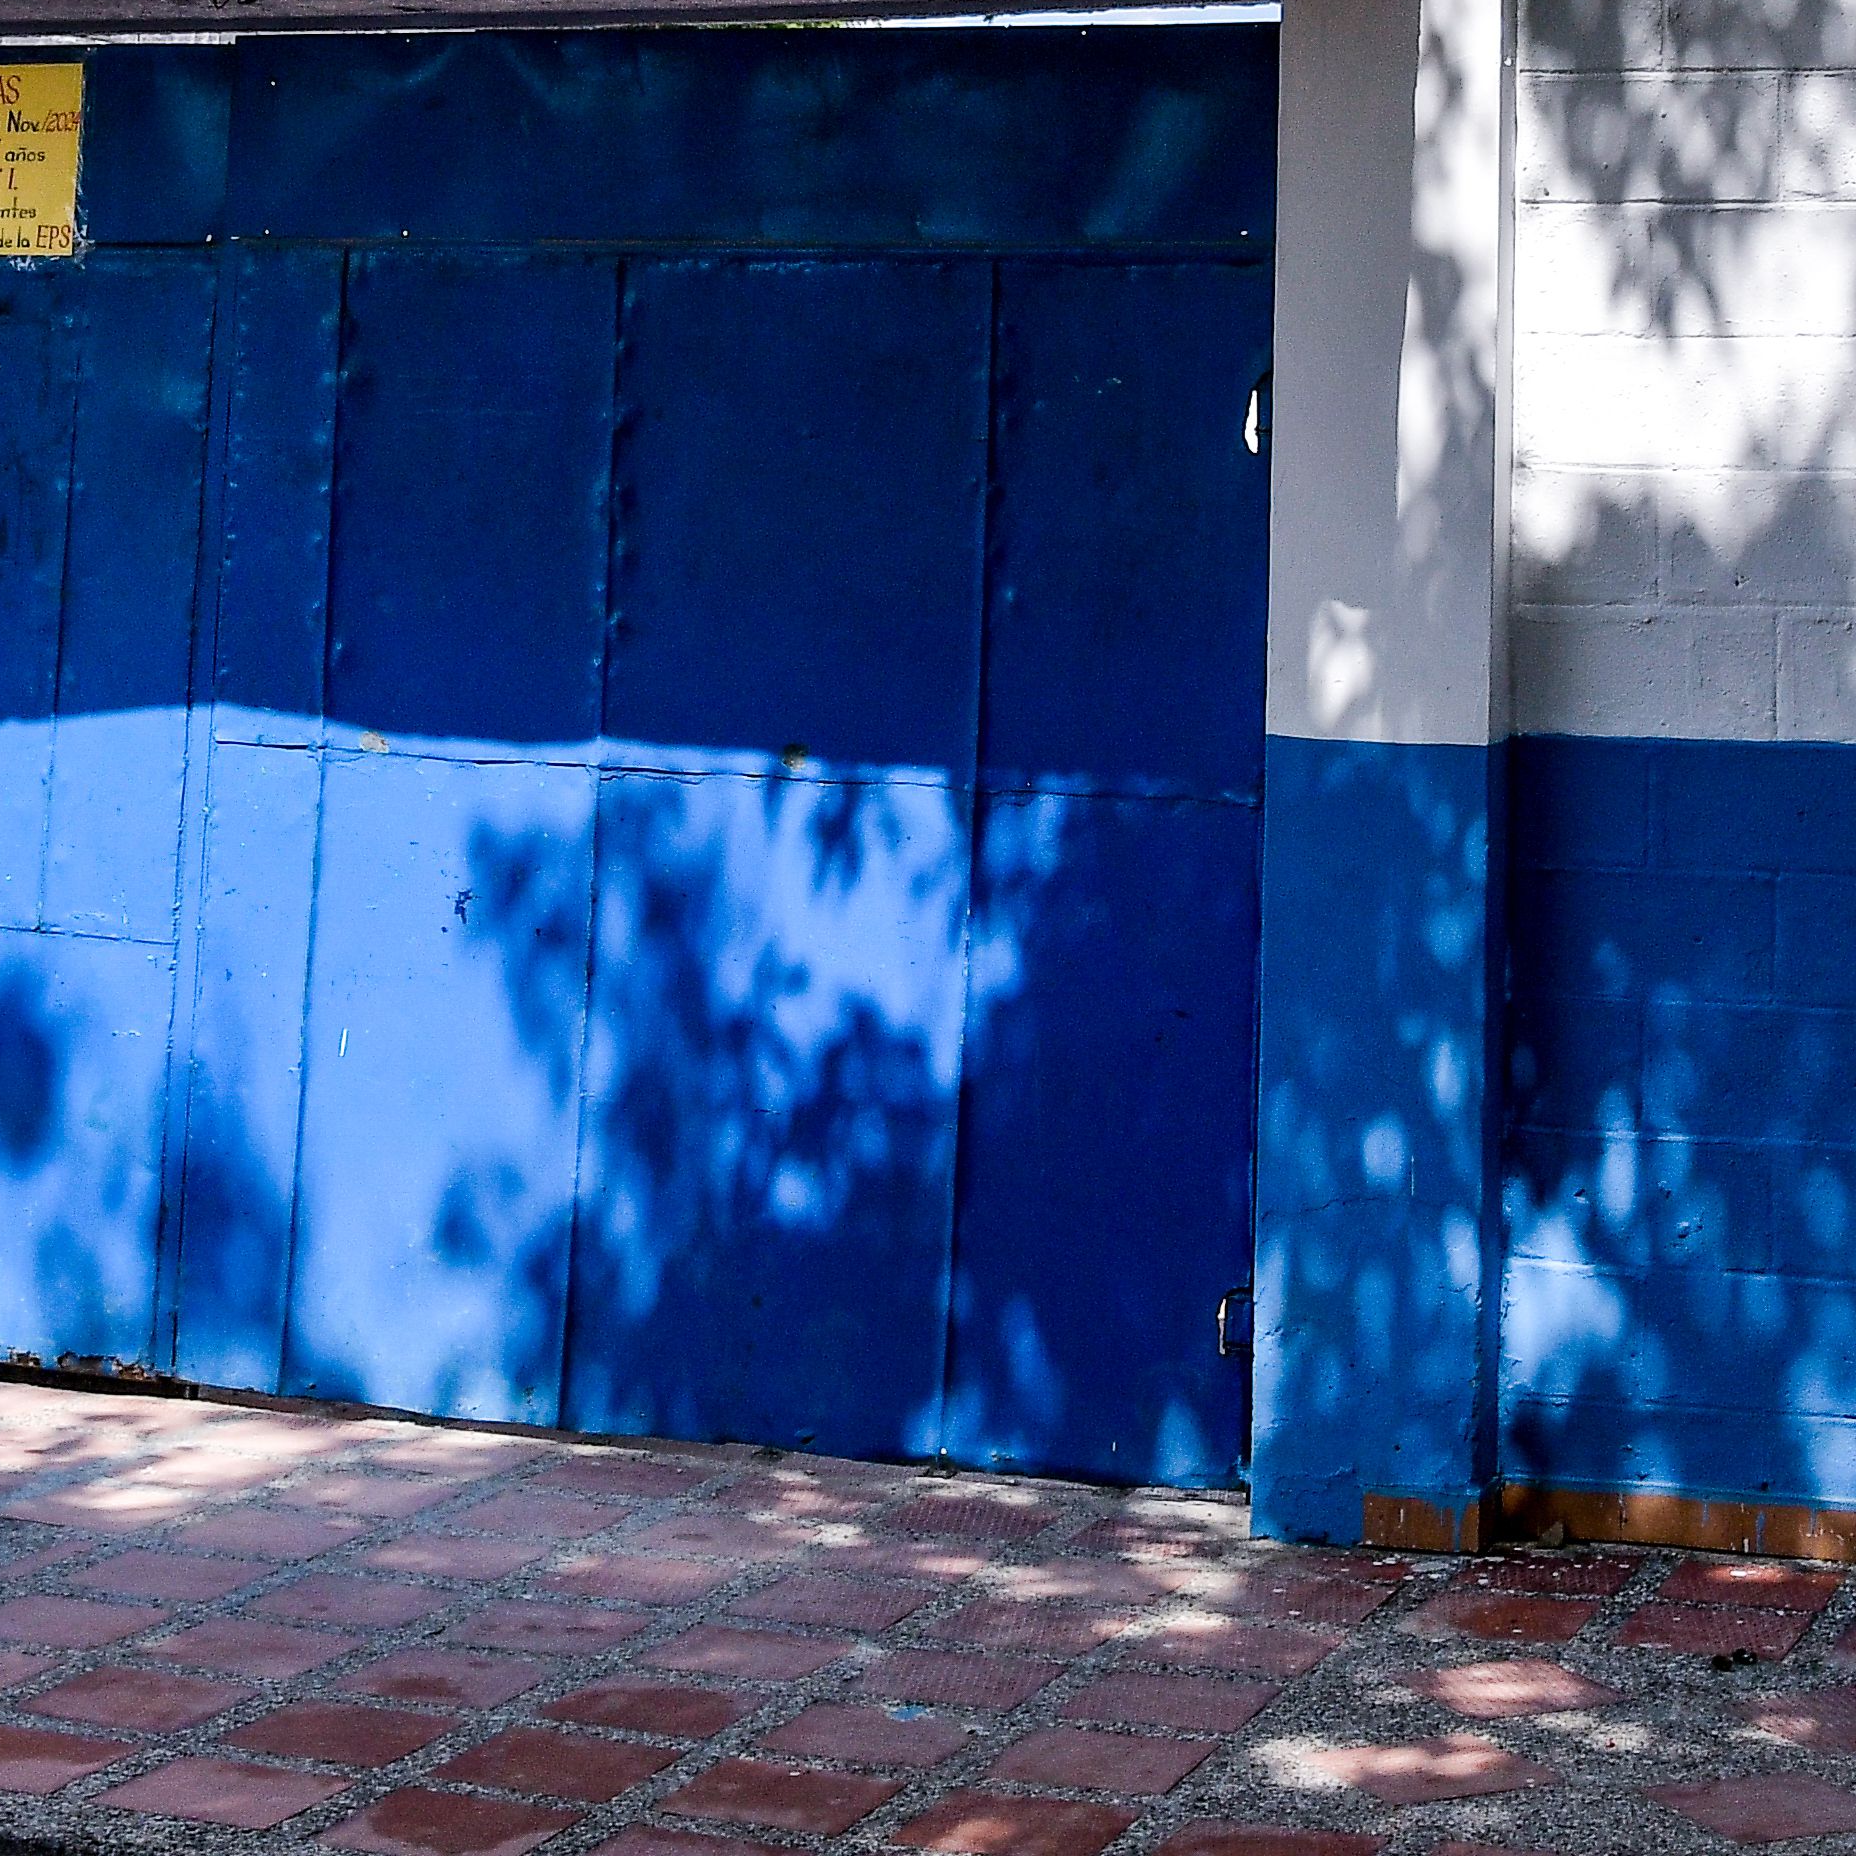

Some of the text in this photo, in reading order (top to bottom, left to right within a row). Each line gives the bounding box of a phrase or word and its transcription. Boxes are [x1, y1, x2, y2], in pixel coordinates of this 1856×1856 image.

[4, 146, 46, 163] años
[16, 225, 31, 248] la
[35, 224, 72, 250] EPS
